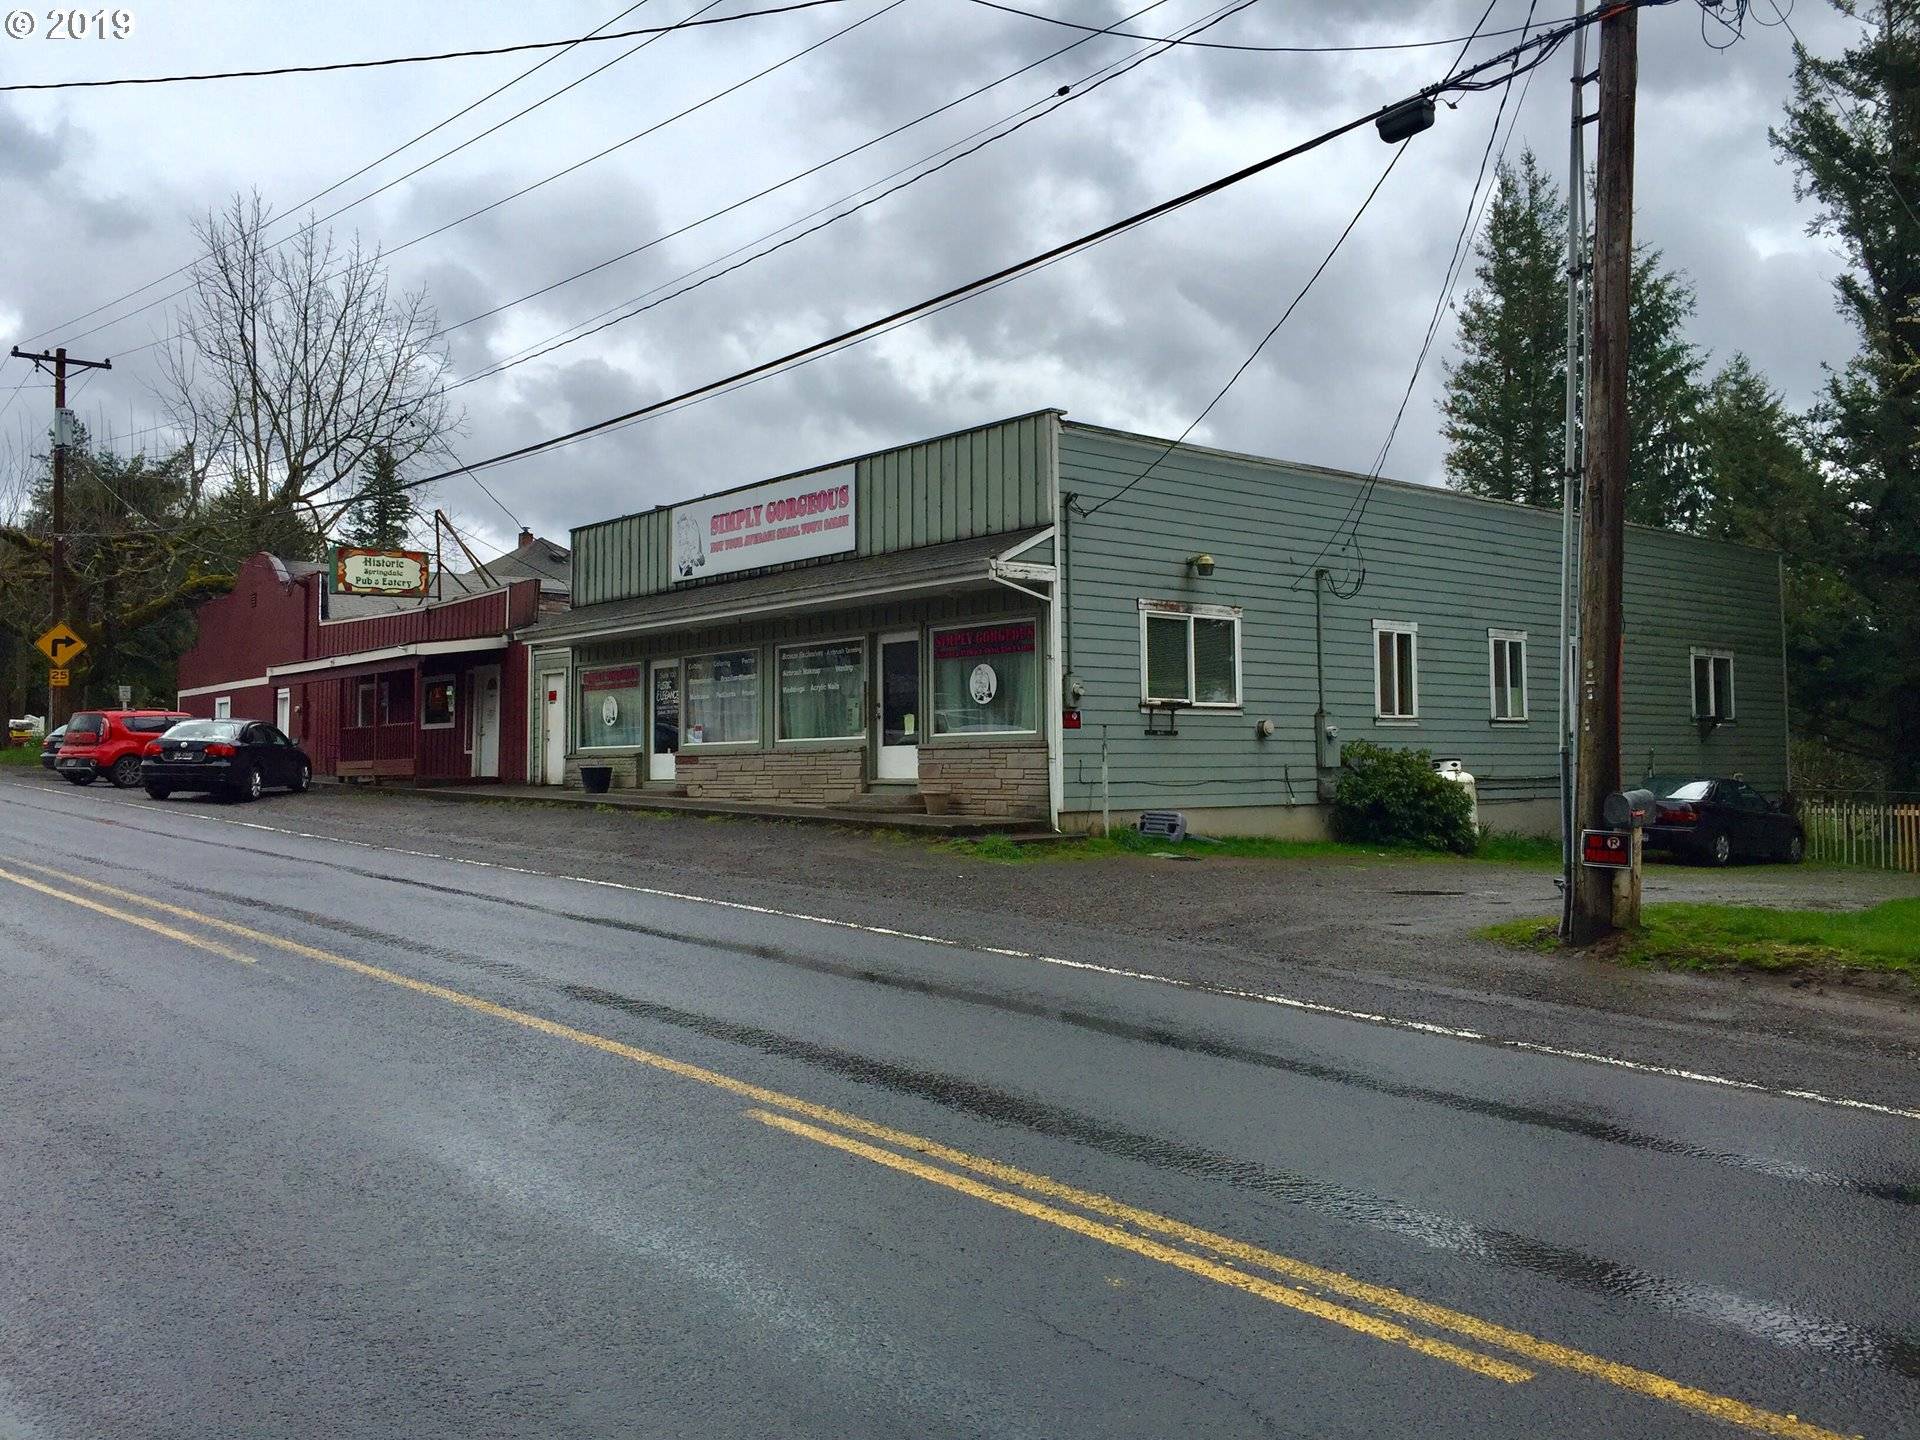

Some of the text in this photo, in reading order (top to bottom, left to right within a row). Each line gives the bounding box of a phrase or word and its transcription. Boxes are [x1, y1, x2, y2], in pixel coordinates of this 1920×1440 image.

[710, 485, 850, 536] SIMPLY GORGEOUS
[744, 528, 776, 546] AVERAGE
[777, 523, 800, 540] SMALL
[362, 557, 404, 568] Historic
[363, 568, 404, 577] Springdale
[355, 576, 373, 585] Pub
[382, 577, 412, 588] Eatery
[51, 670, 68, 680] 25
